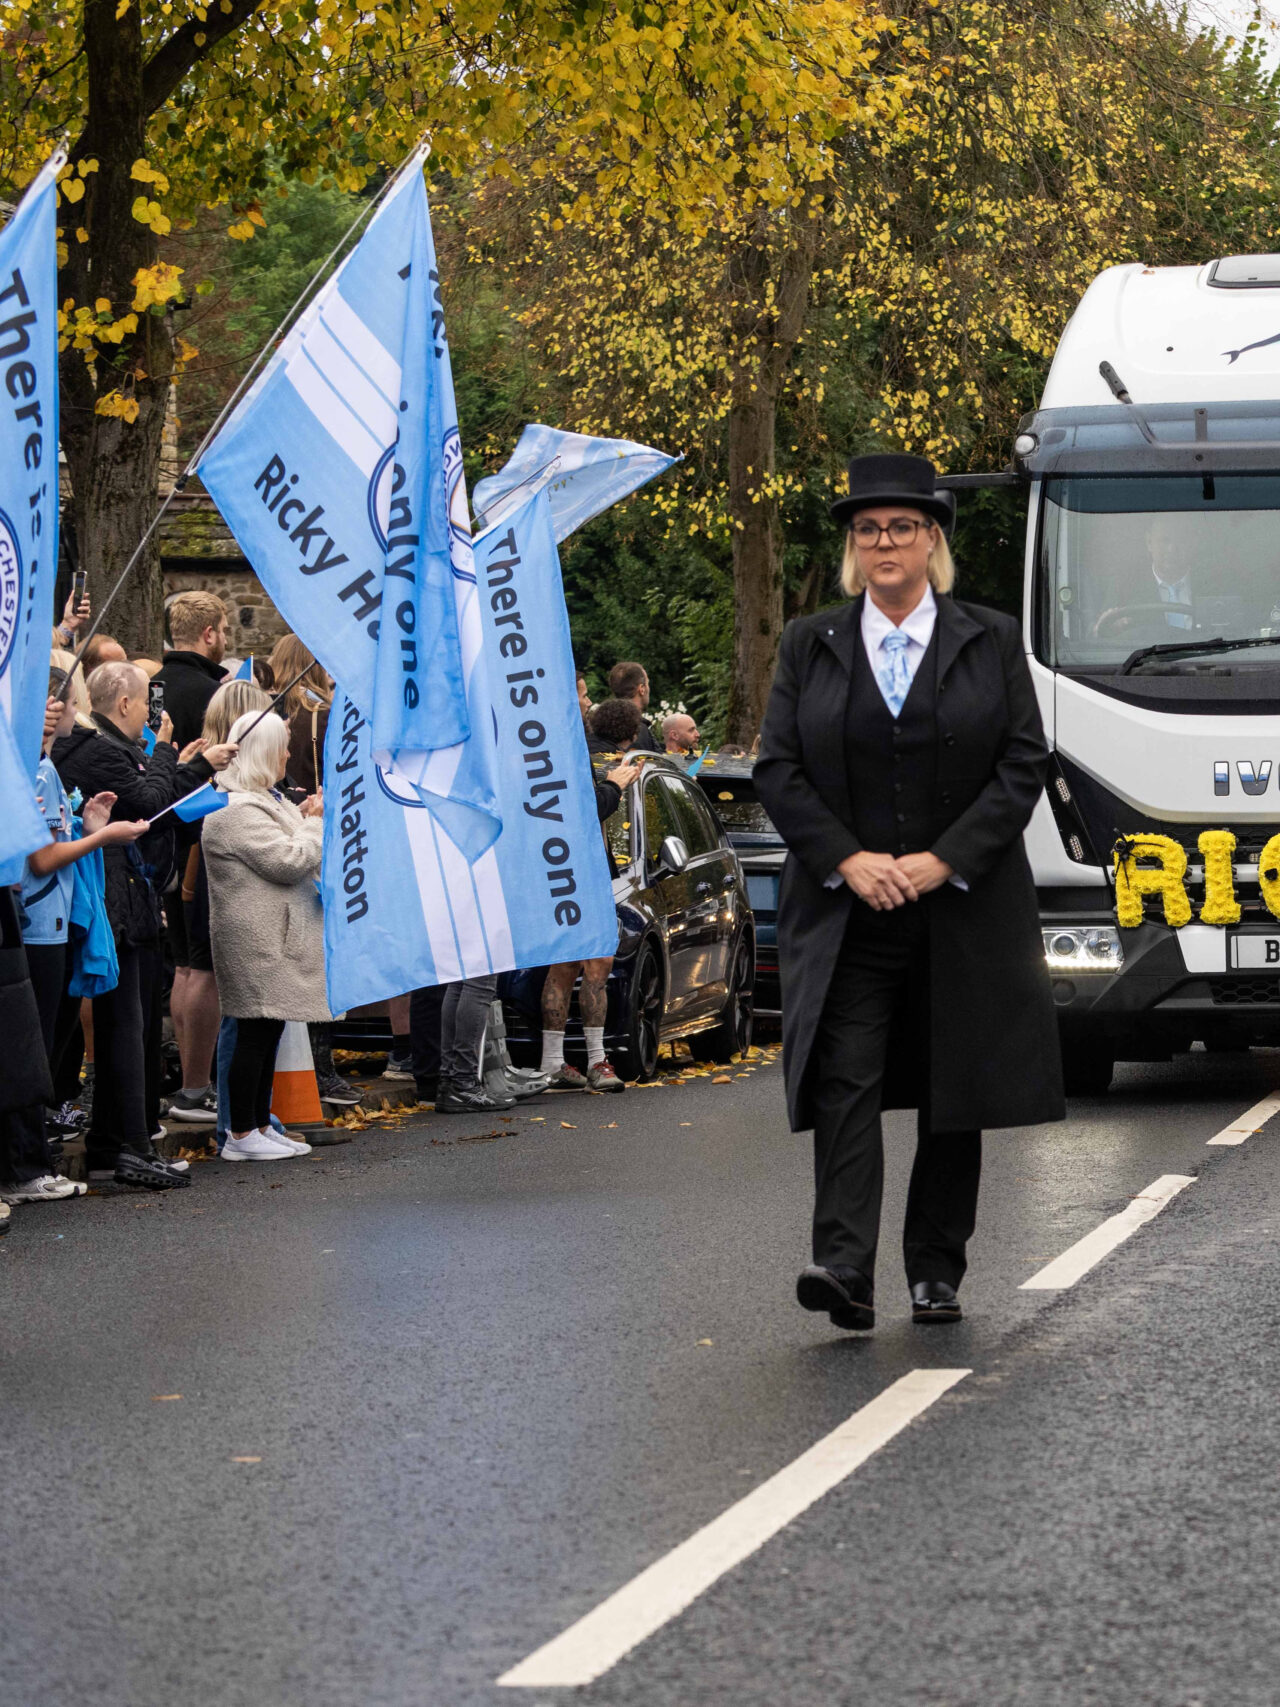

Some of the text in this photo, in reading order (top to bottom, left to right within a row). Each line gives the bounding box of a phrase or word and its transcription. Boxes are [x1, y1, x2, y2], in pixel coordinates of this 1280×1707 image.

[0, 268, 42, 471] There
[253, 453, 350, 576] Ricky
[396, 600, 420, 711] one
[486, 527, 582, 927] There is only one
[340, 774, 369, 924] Hatton
